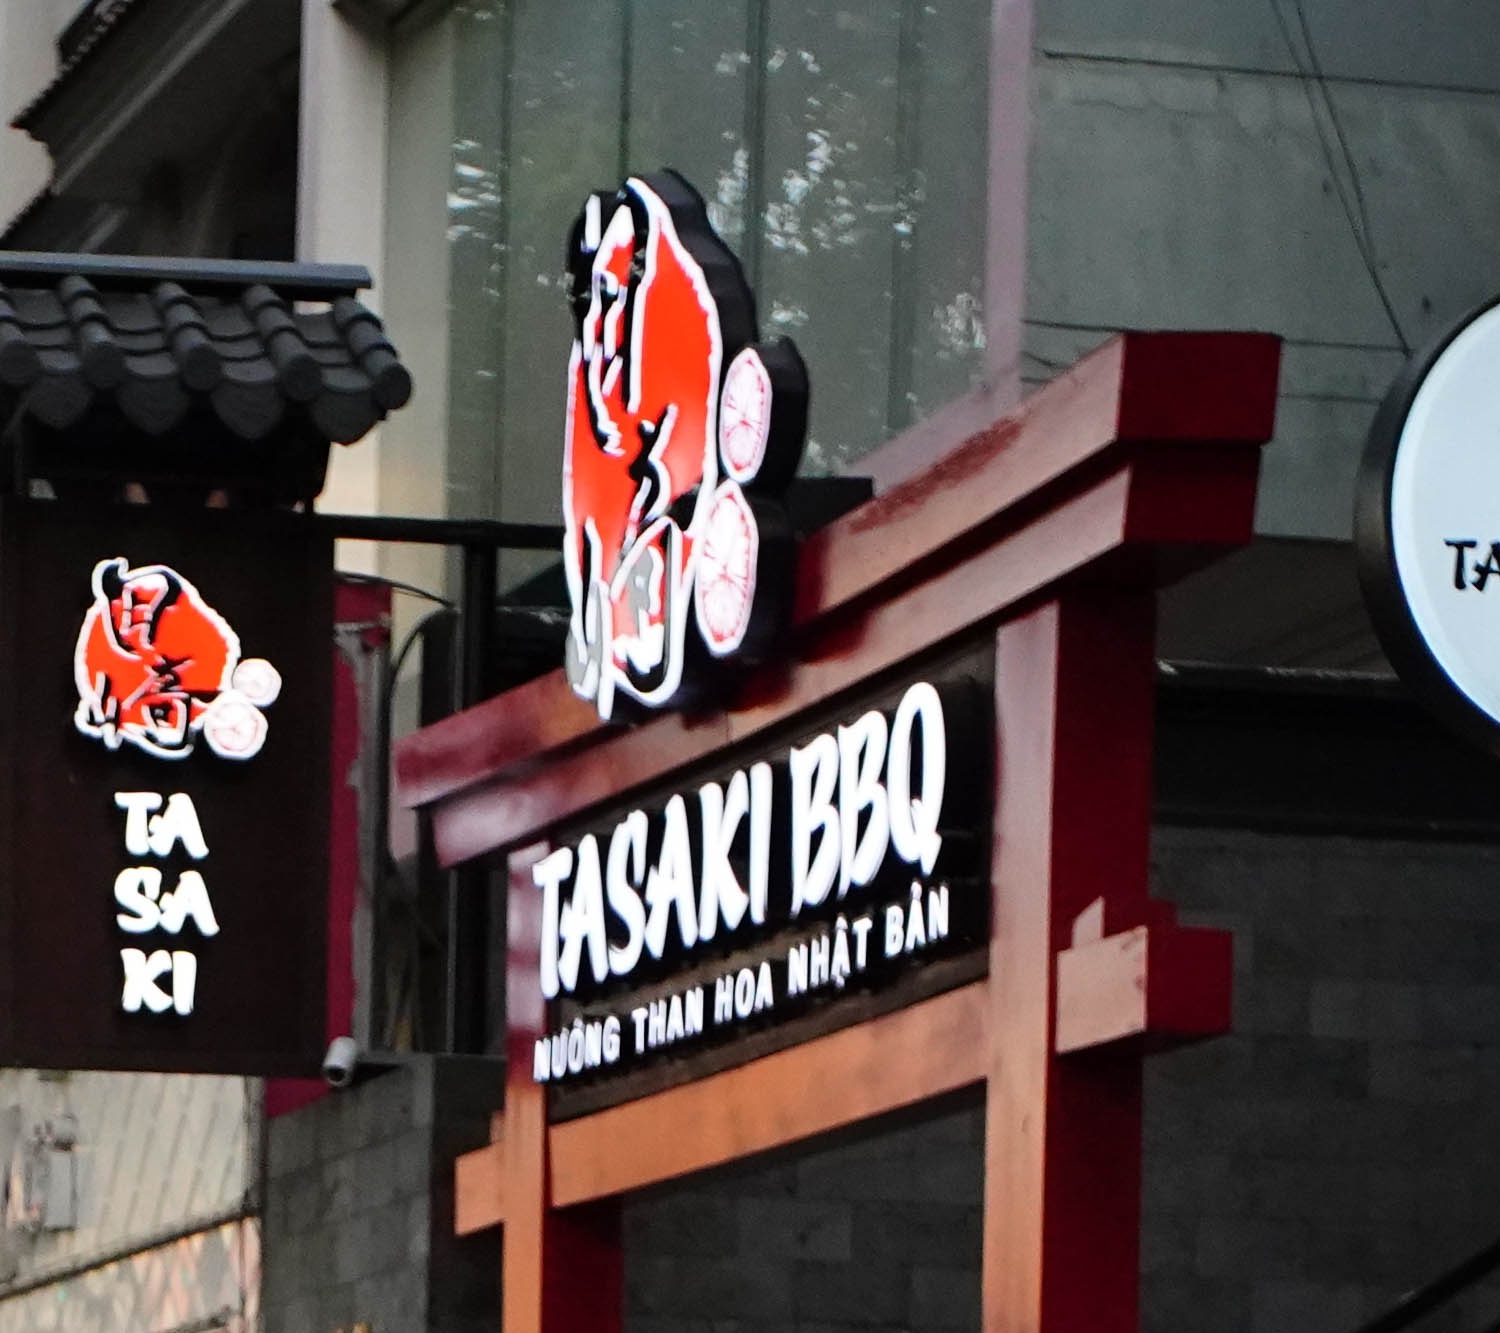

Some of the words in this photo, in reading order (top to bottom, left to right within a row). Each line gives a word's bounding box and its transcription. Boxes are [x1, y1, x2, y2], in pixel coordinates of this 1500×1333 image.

[114, 792, 210, 859] TA
[532, 761, 772, 999] TASAKI
[790, 681, 946, 917] BBQ
[114, 866, 220, 937] SA
[120, 948, 197, 1016] KI
[631, 984, 705, 1054] THAN
[714, 961, 774, 1024] HOA
[786, 912, 873, 997] NHẬT
